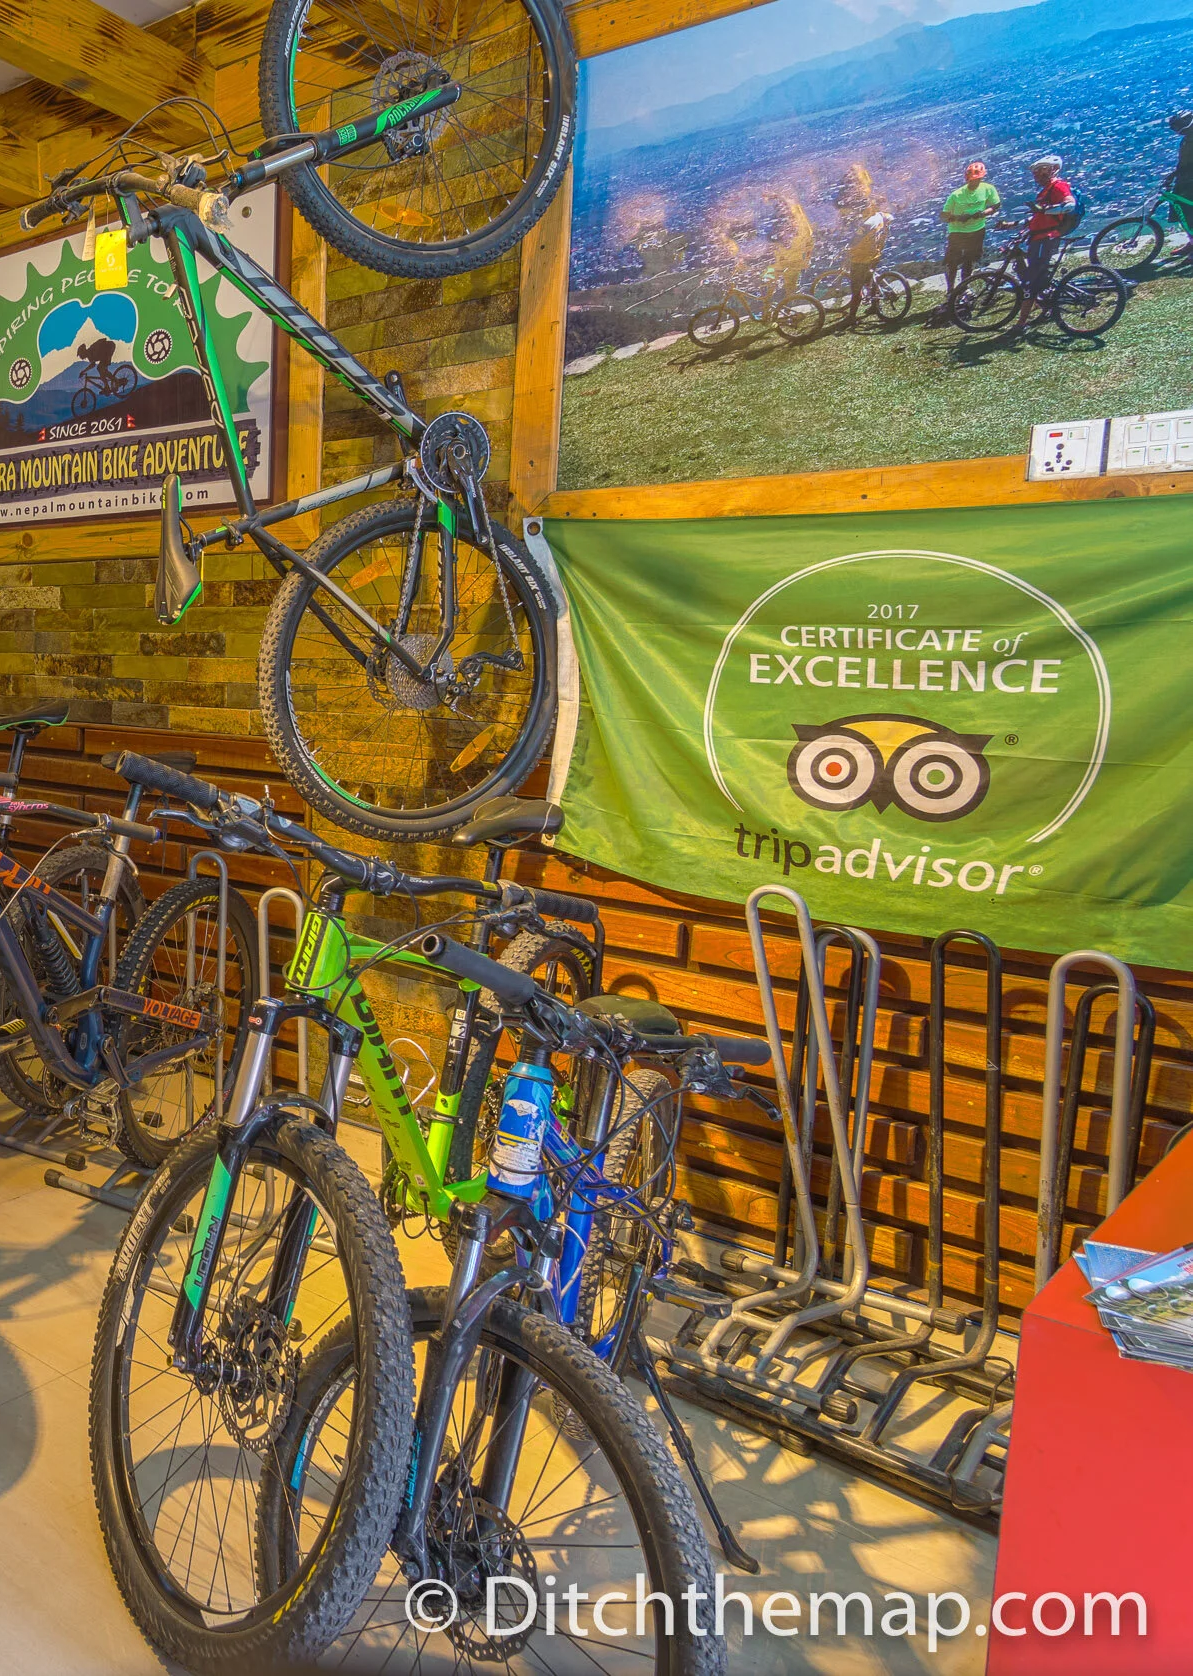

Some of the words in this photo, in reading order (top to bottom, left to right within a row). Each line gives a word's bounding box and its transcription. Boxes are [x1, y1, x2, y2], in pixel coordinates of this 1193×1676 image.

[61, 267, 141, 294] PEOE
[48, 424, 88, 440] SINCE
[91, 417, 123, 433] 2061
[19, 453, 99, 491] MOUNTAIN
[102, 444, 139, 481] BIKE
[142, 431, 249, 475] ADVENTUE
[867, 604, 920, 620] 2017
[780, 625, 983, 652] CERTIFICATE
[993, 632, 1028, 657] of
[749, 652, 1062, 694] EXCELLENCE
[734, 822, 1025, 895] tripadvisor
[293, 913, 323, 989] GIANT
[144, 998, 199, 1027] VOLTAGE
[116, 1201, 156, 1282] ARDENT
